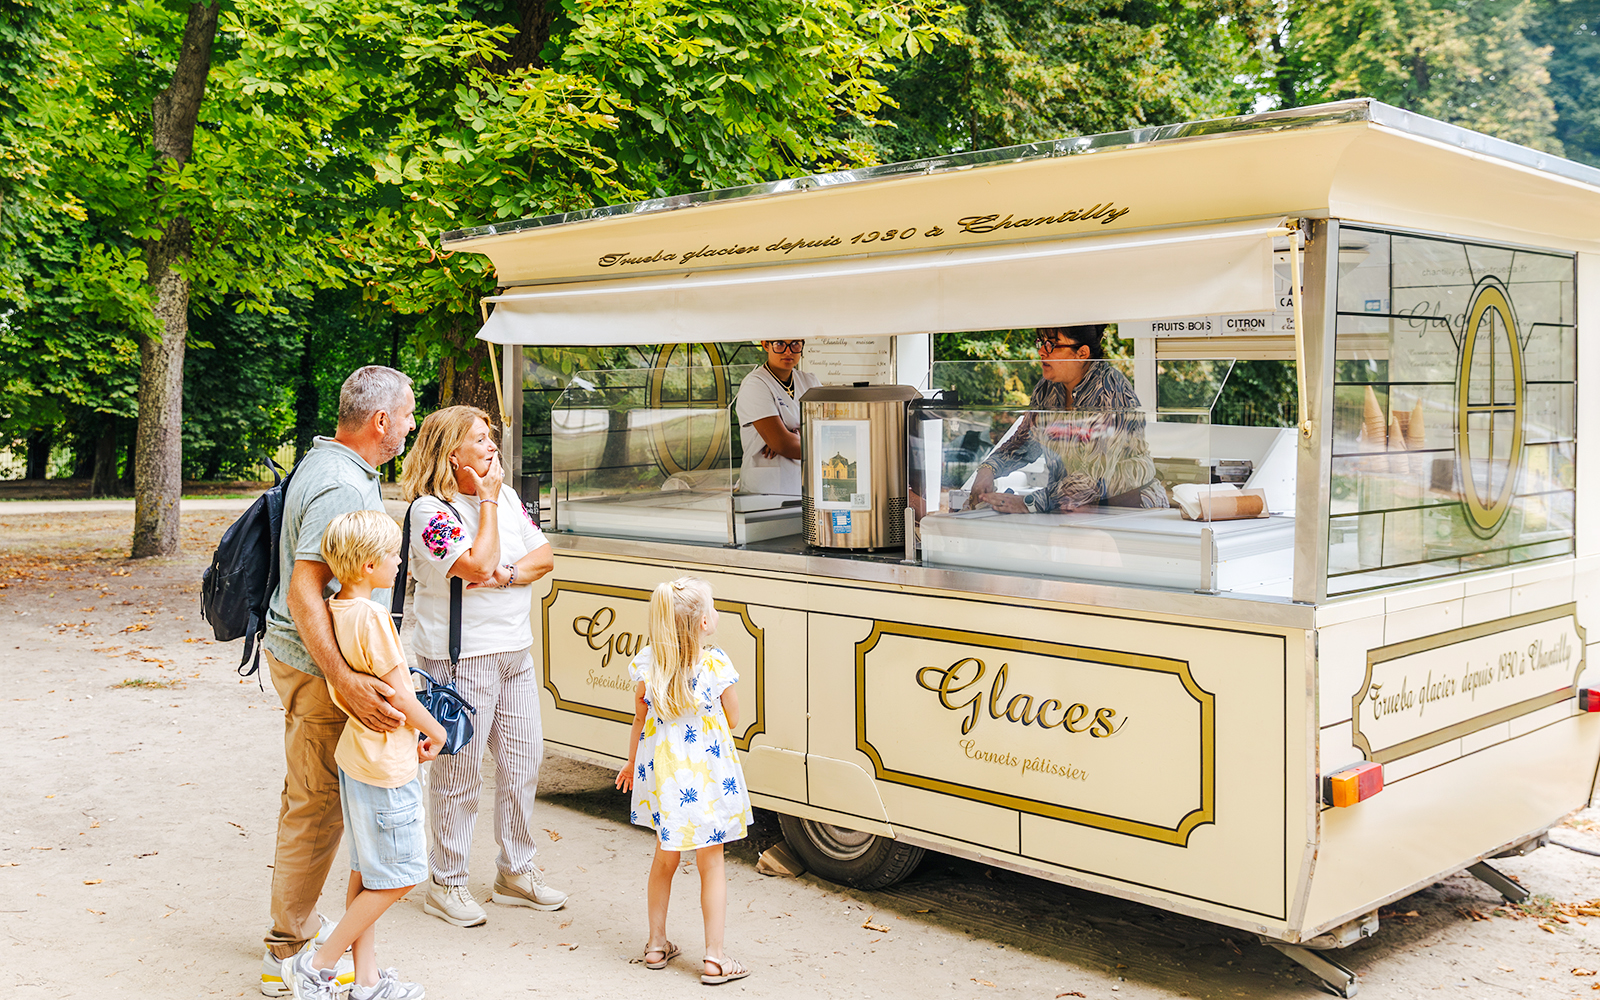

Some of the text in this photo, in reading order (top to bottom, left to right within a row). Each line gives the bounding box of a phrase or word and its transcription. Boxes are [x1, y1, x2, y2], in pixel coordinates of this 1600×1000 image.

[598, 201, 1130, 268] Trueba glacier depuis 1930 à Chantilly
[1226, 318, 1265, 328] CITRON
[1397, 300, 1492, 339] Glacs
[586, 668, 632, 692] Spécialité
[915, 657, 1128, 738] Glaces
[1369, 675, 1417, 721] Trueba
[1418, 669, 1457, 718] glacier
[1461, 662, 1494, 701] depuis
[1497, 651, 1518, 682] 1930
[1527, 632, 1572, 672] Chantilly
[959, 738, 1090, 782] Cornets pâtissier
